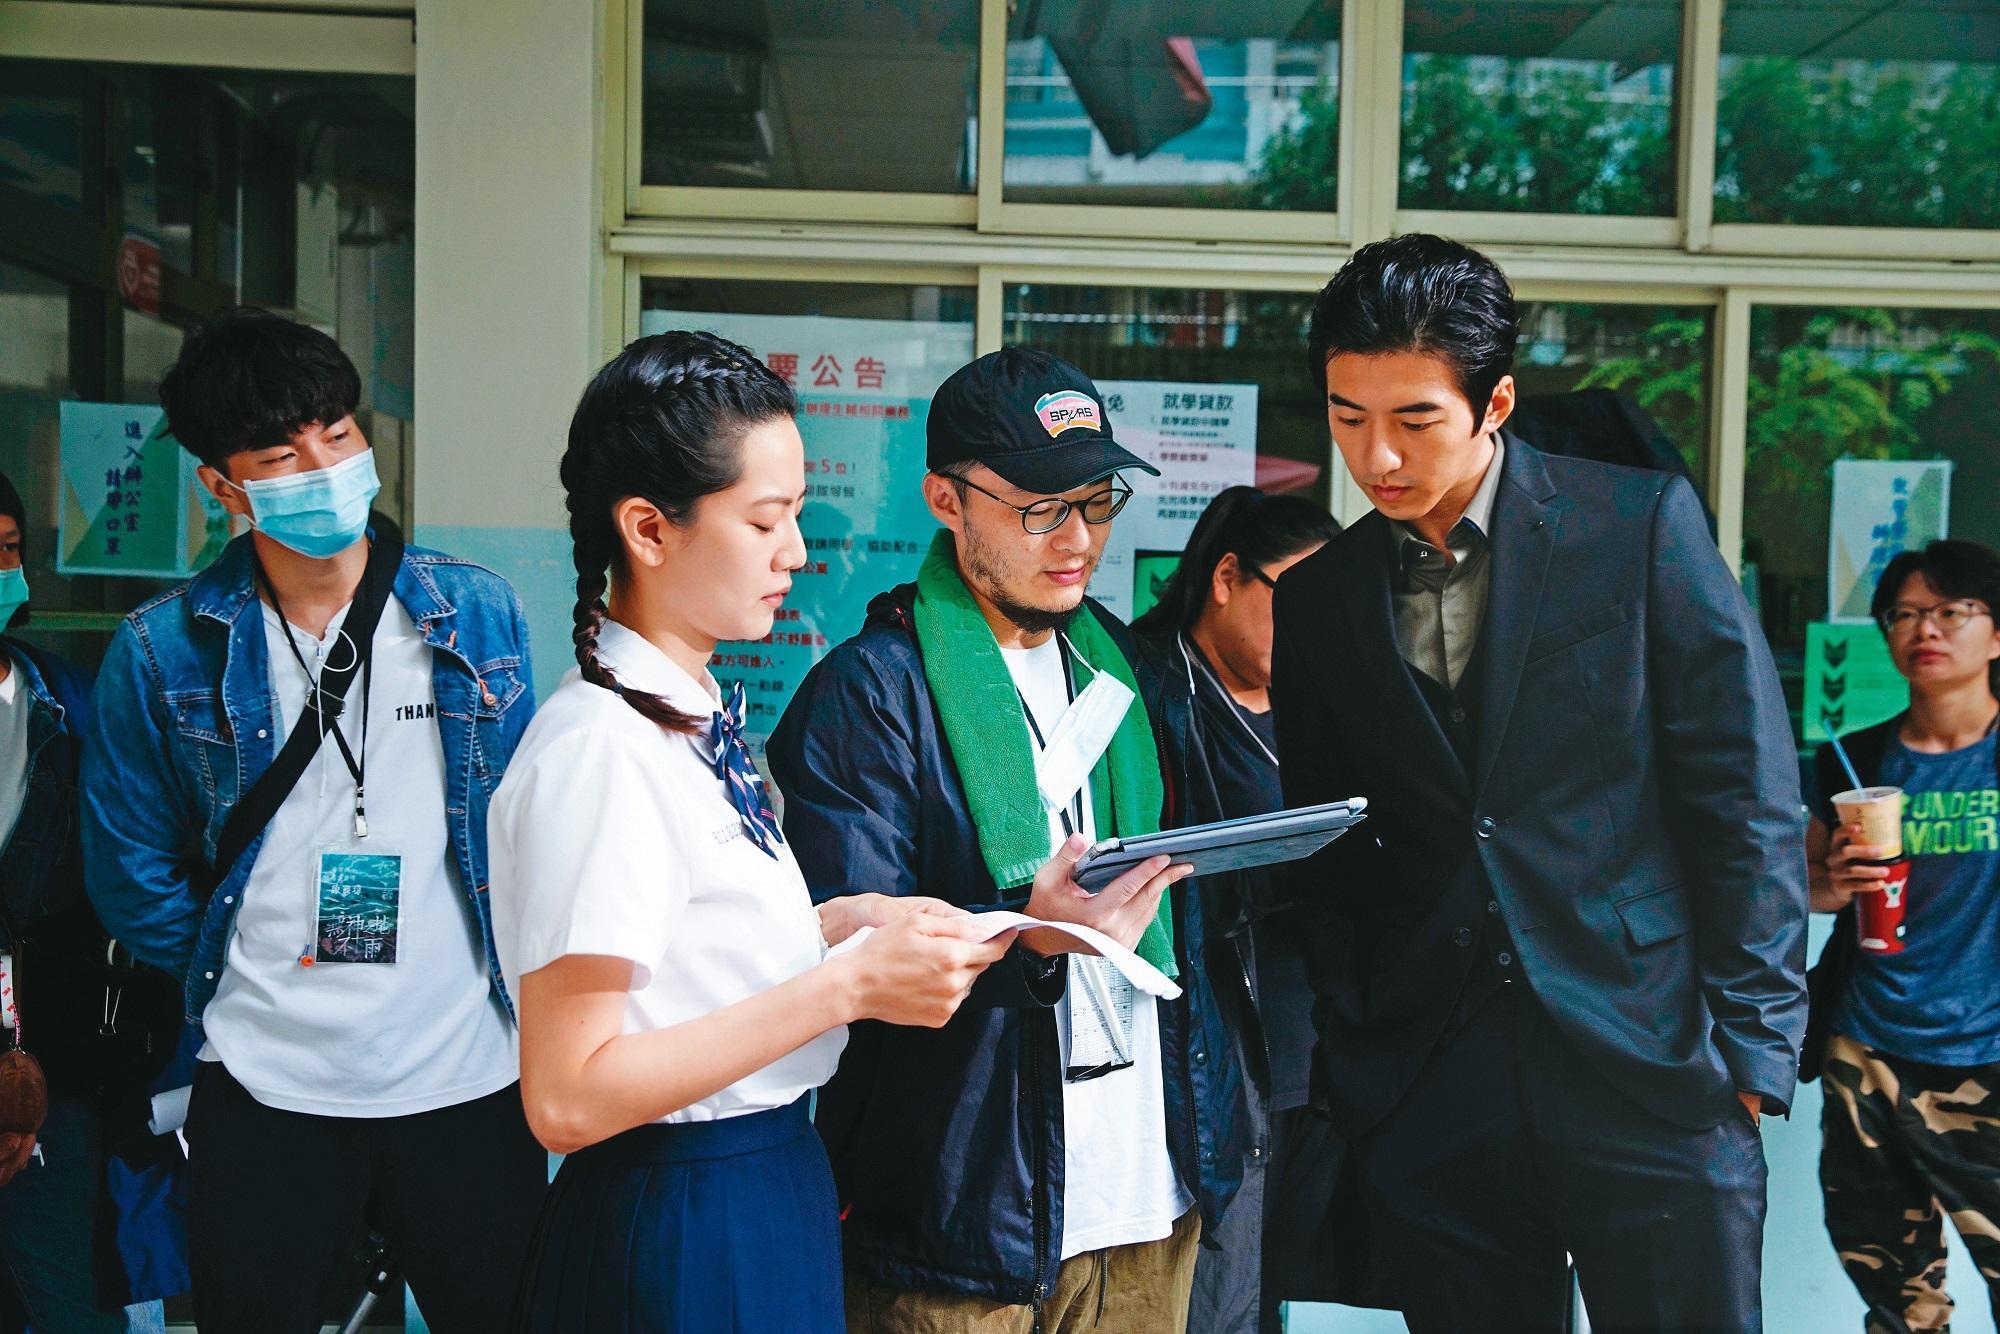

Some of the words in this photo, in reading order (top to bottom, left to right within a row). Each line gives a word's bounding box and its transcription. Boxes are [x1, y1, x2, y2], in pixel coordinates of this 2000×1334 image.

[767, 352, 886, 389] 要公告
[1162, 391, 1233, 412] 就學貸款
[1050, 407, 1093, 424] SPURS
[124, 420, 144, 533] 進入辦公室
[395, 703, 434, 721] THAN
[1911, 790, 2000, 820] UNDER
